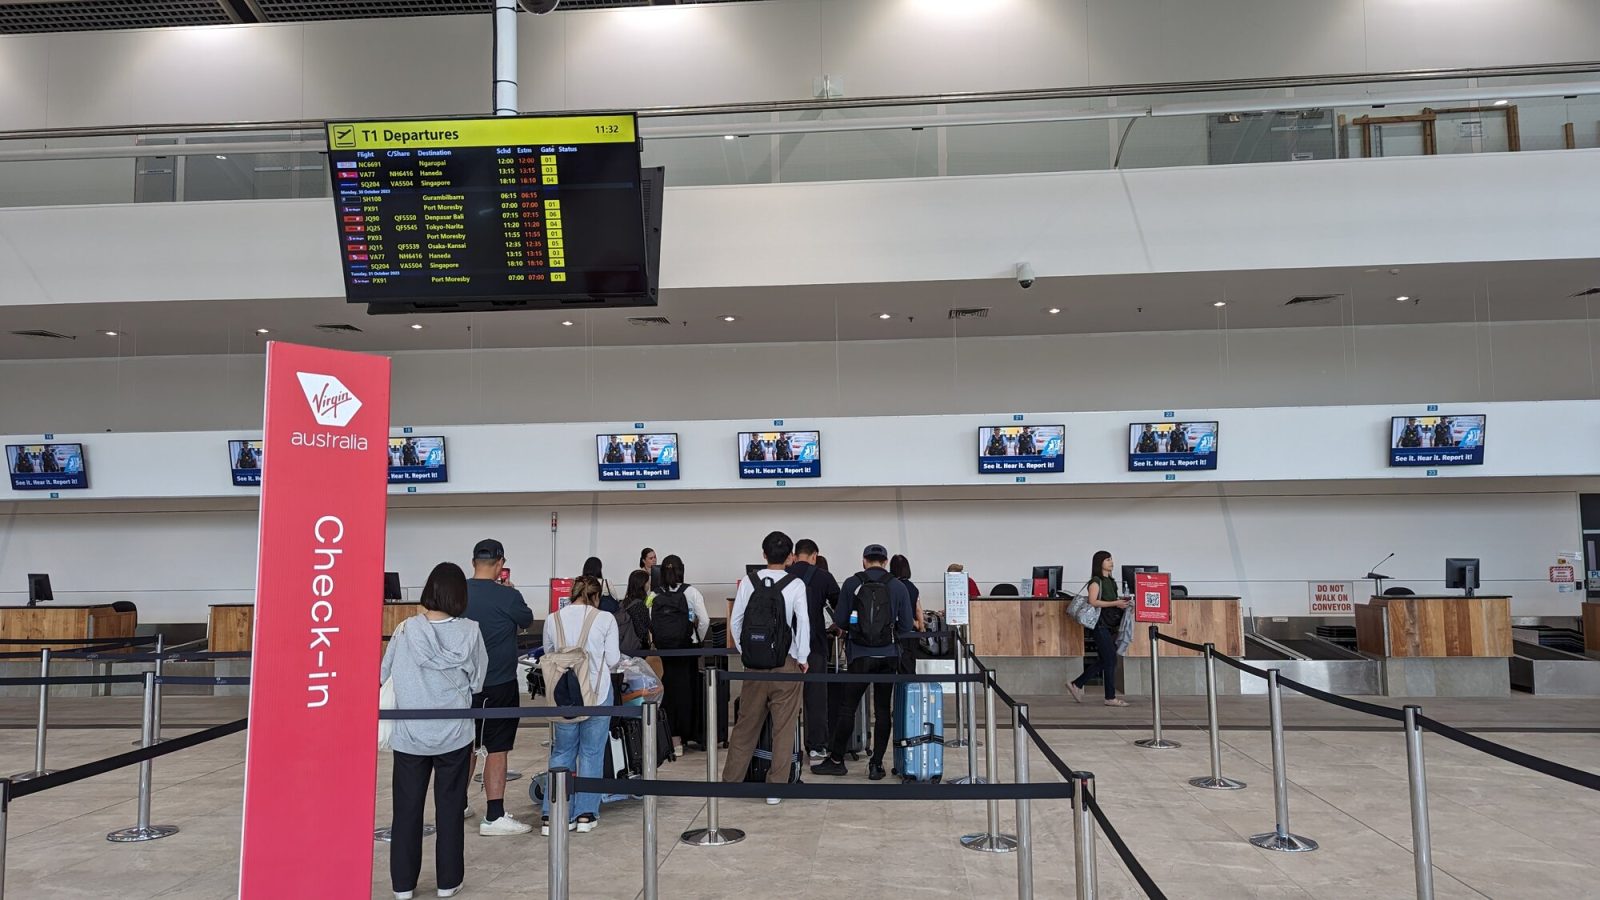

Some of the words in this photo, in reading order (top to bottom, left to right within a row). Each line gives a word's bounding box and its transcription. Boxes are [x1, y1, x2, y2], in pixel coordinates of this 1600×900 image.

[362, 130, 378, 142] T1
[384, 129, 459, 144] Departures
[595, 125, 619, 134] 11:32
[312, 383, 352, 418] Virgin
[291, 432, 368, 451] australia
[307, 515, 344, 708] Check-in
